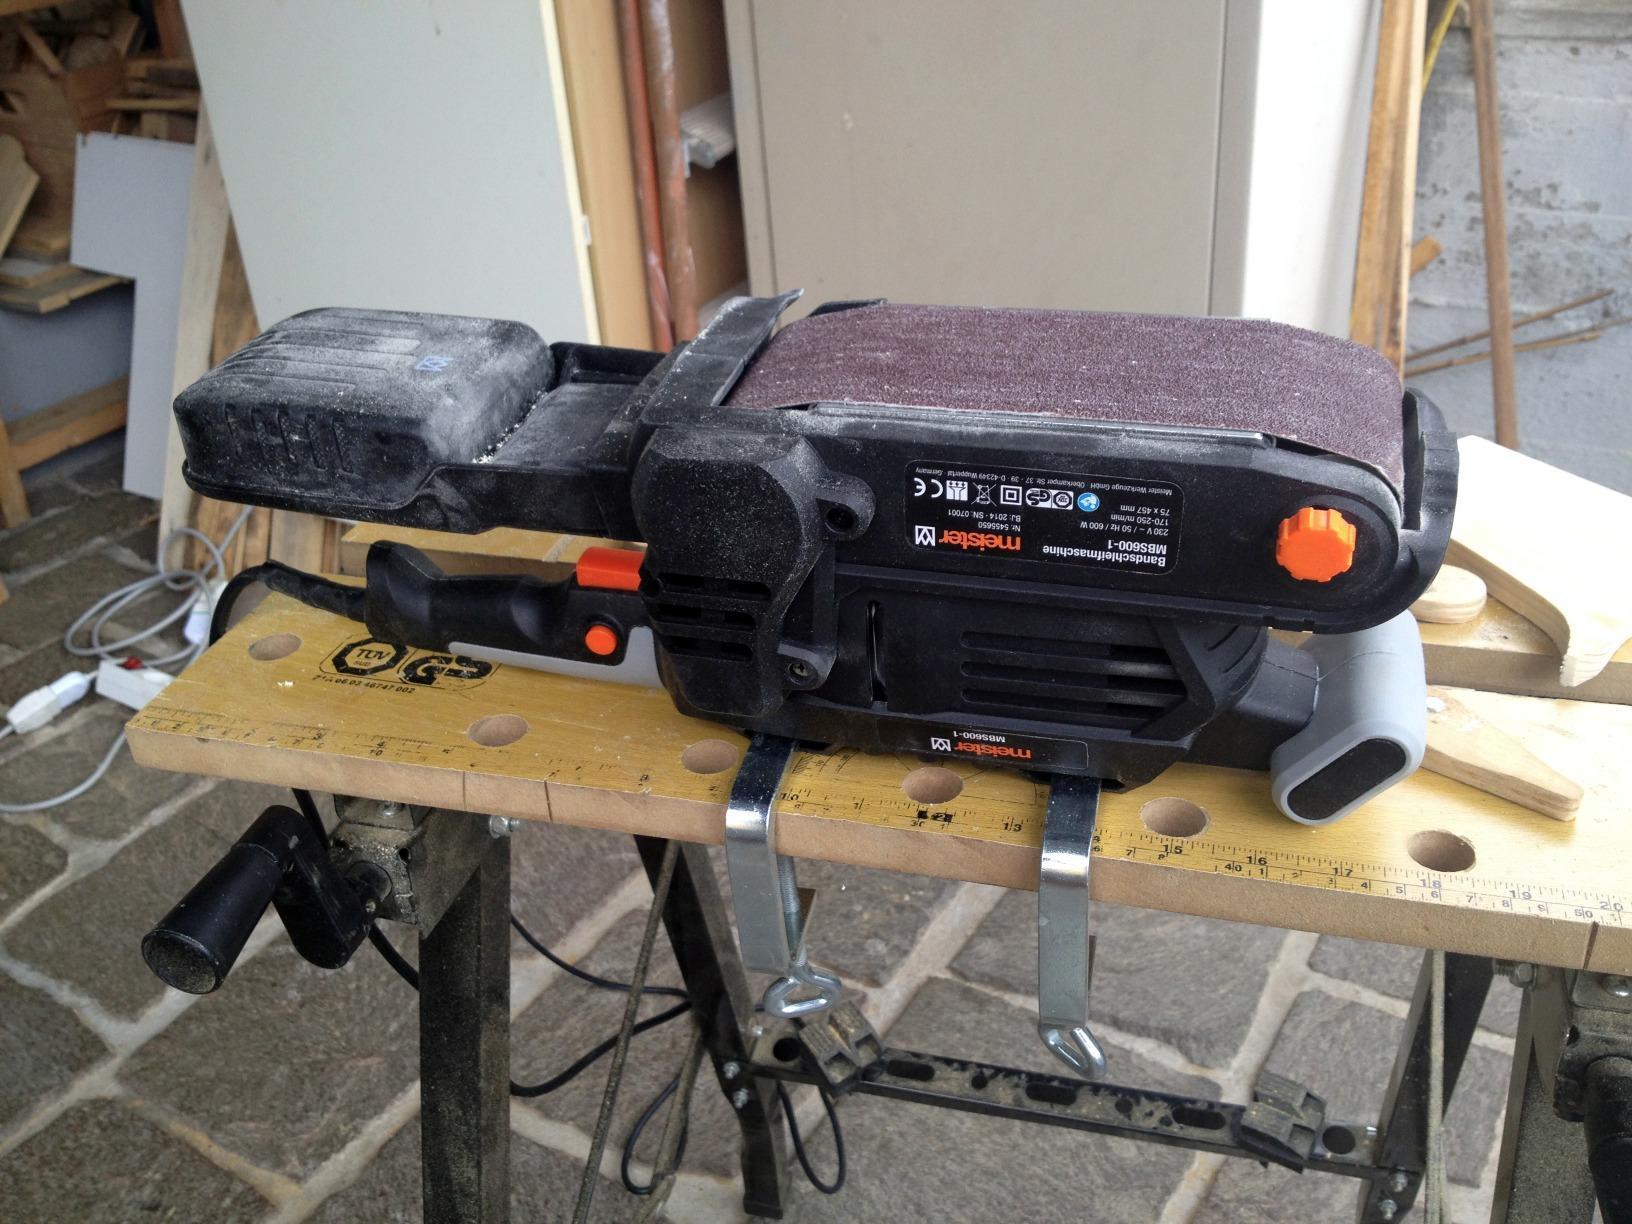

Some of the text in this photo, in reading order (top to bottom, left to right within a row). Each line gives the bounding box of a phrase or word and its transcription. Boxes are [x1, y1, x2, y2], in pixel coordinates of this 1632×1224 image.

[947, 471, 977, 479] Wuppertal
[1112, 484, 1146, 493] Werkzeuge
[948, 509, 969, 517] 07001
[1137, 506, 1152, 514] 457
[1160, 508, 1170, 516] 75
[1111, 514, 1168, 525] 170-250 m/min
[978, 521, 1009, 530] 5455650
[1154, 528, 1168, 536] 230
[939, 530, 1021, 551] meister
[1108, 540, 1167, 554] MBS600-1
[1043, 546, 1165, 566] Bandschleifmaschine
[953, 731, 1005, 743] MBS600-1
[955, 742, 1031, 759] meister
